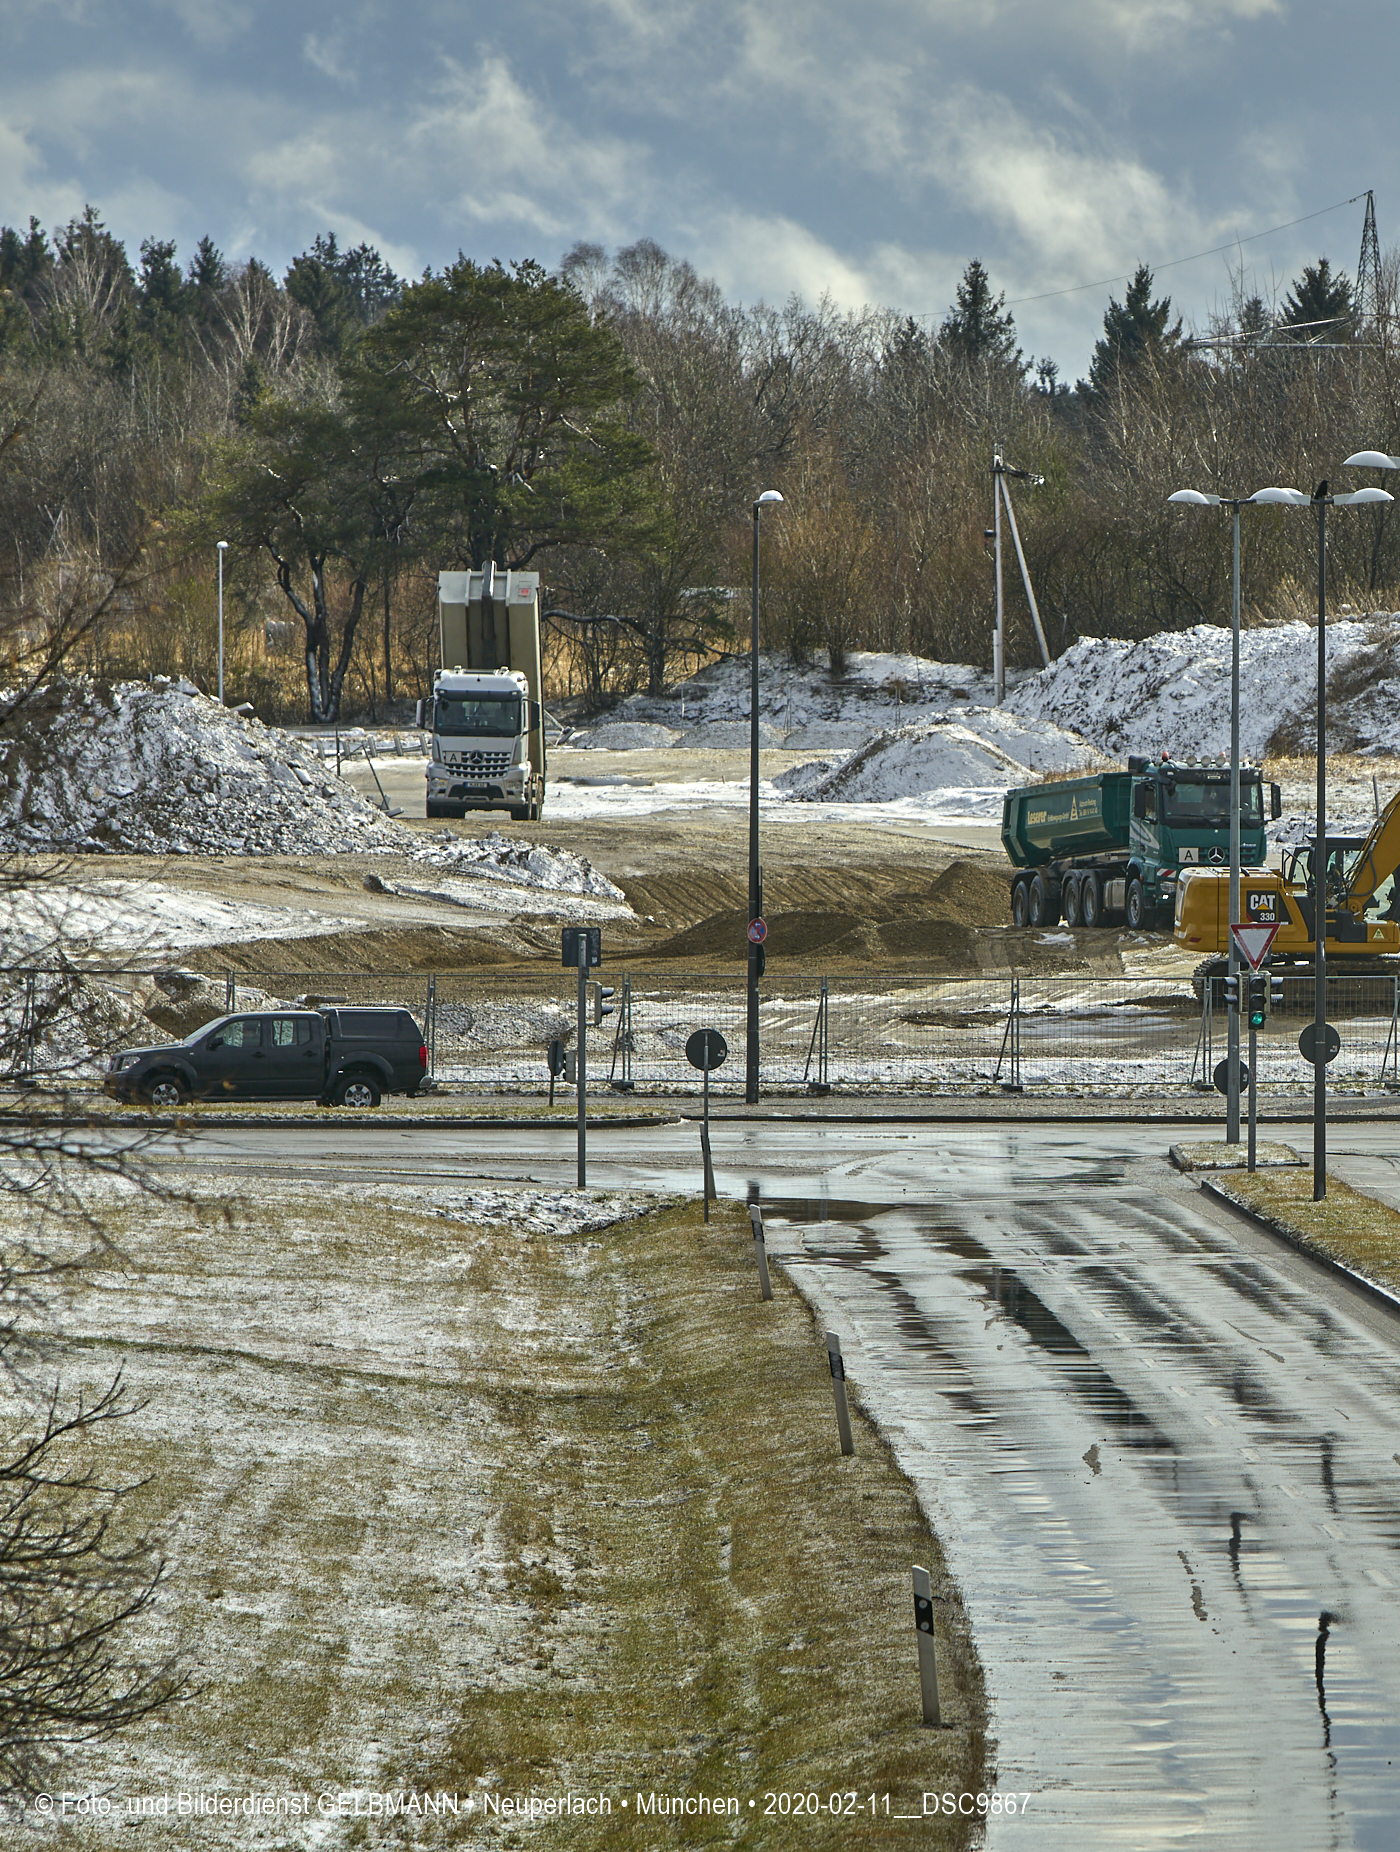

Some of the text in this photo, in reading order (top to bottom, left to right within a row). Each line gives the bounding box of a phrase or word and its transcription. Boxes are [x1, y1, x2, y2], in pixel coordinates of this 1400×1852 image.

[450, 753, 457, 762] A
[1184, 849, 1193, 861] A
[1250, 894, 1275, 910] CAT
[1259, 912, 1275, 921] 330
